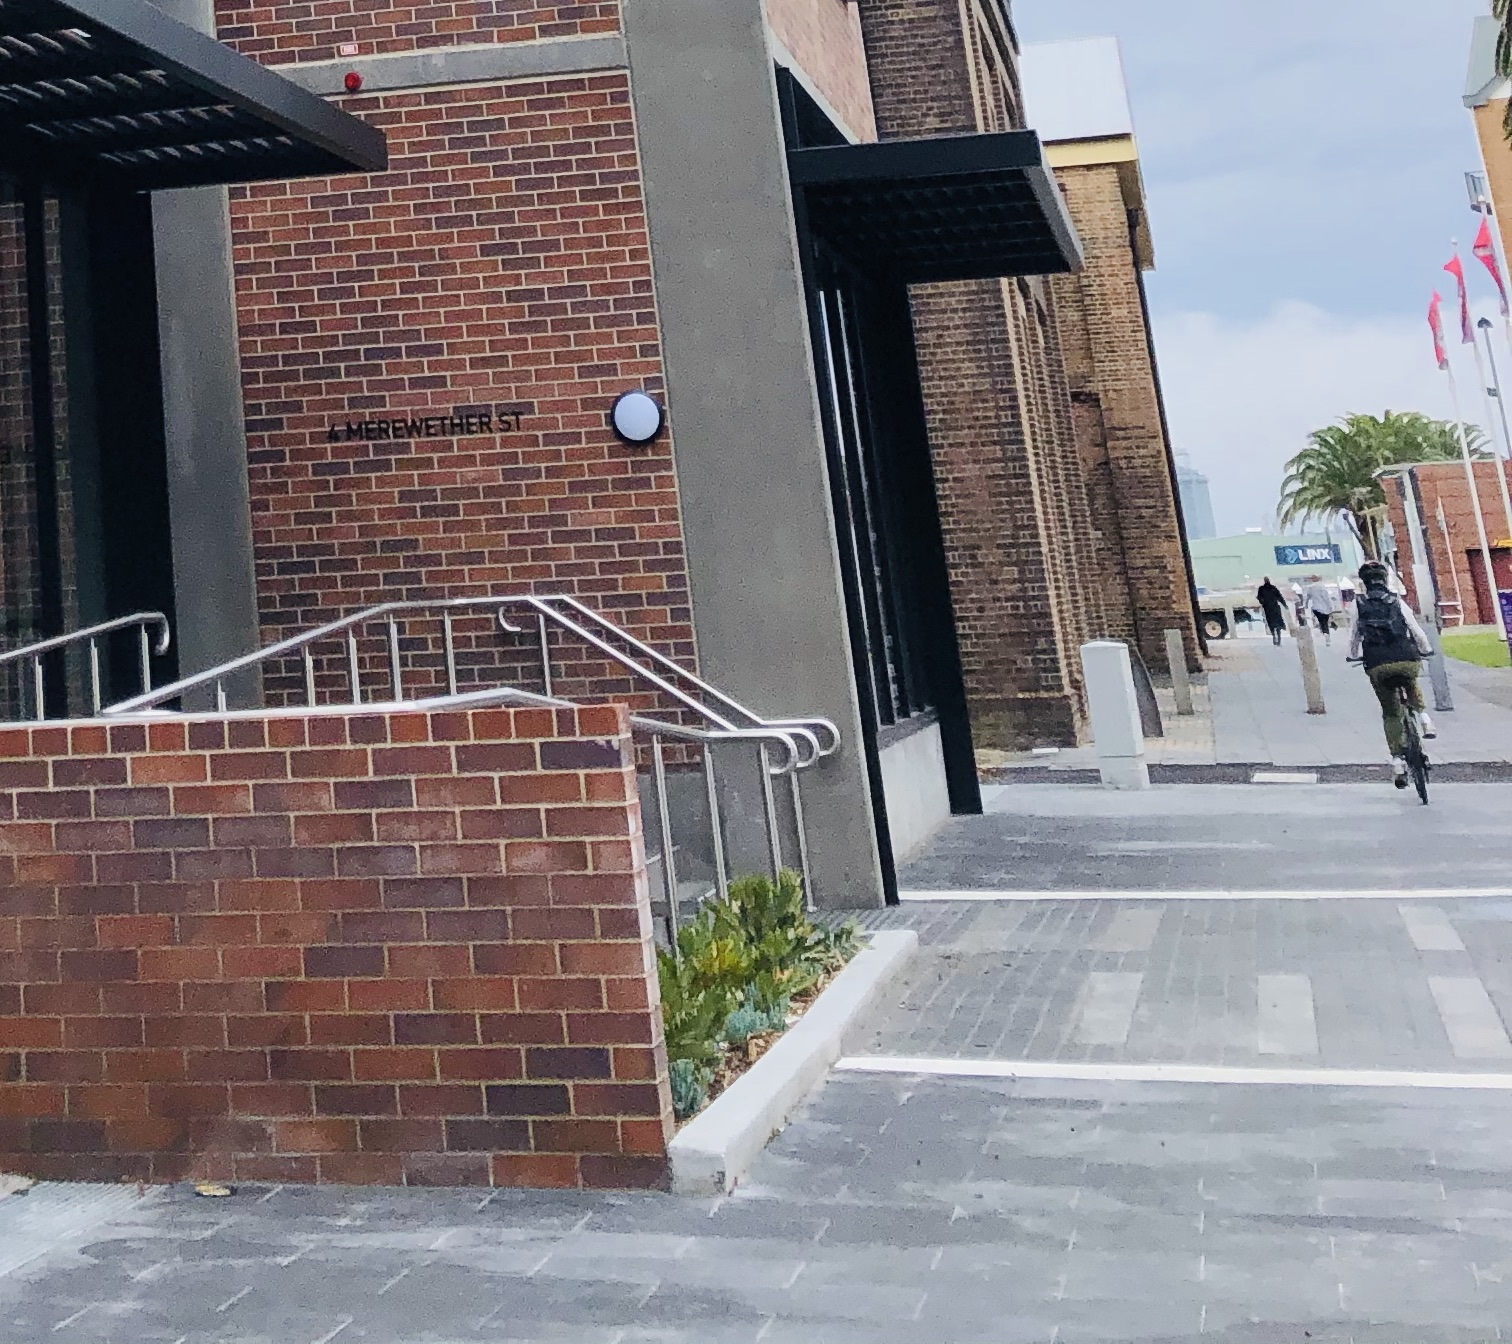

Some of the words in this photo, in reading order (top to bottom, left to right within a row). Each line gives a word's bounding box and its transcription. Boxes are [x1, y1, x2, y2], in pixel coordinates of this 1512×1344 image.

[346, 413, 493, 441] MEREWETHER
[499, 412, 523, 432] ST
[1298, 548, 1331, 560] LINX
